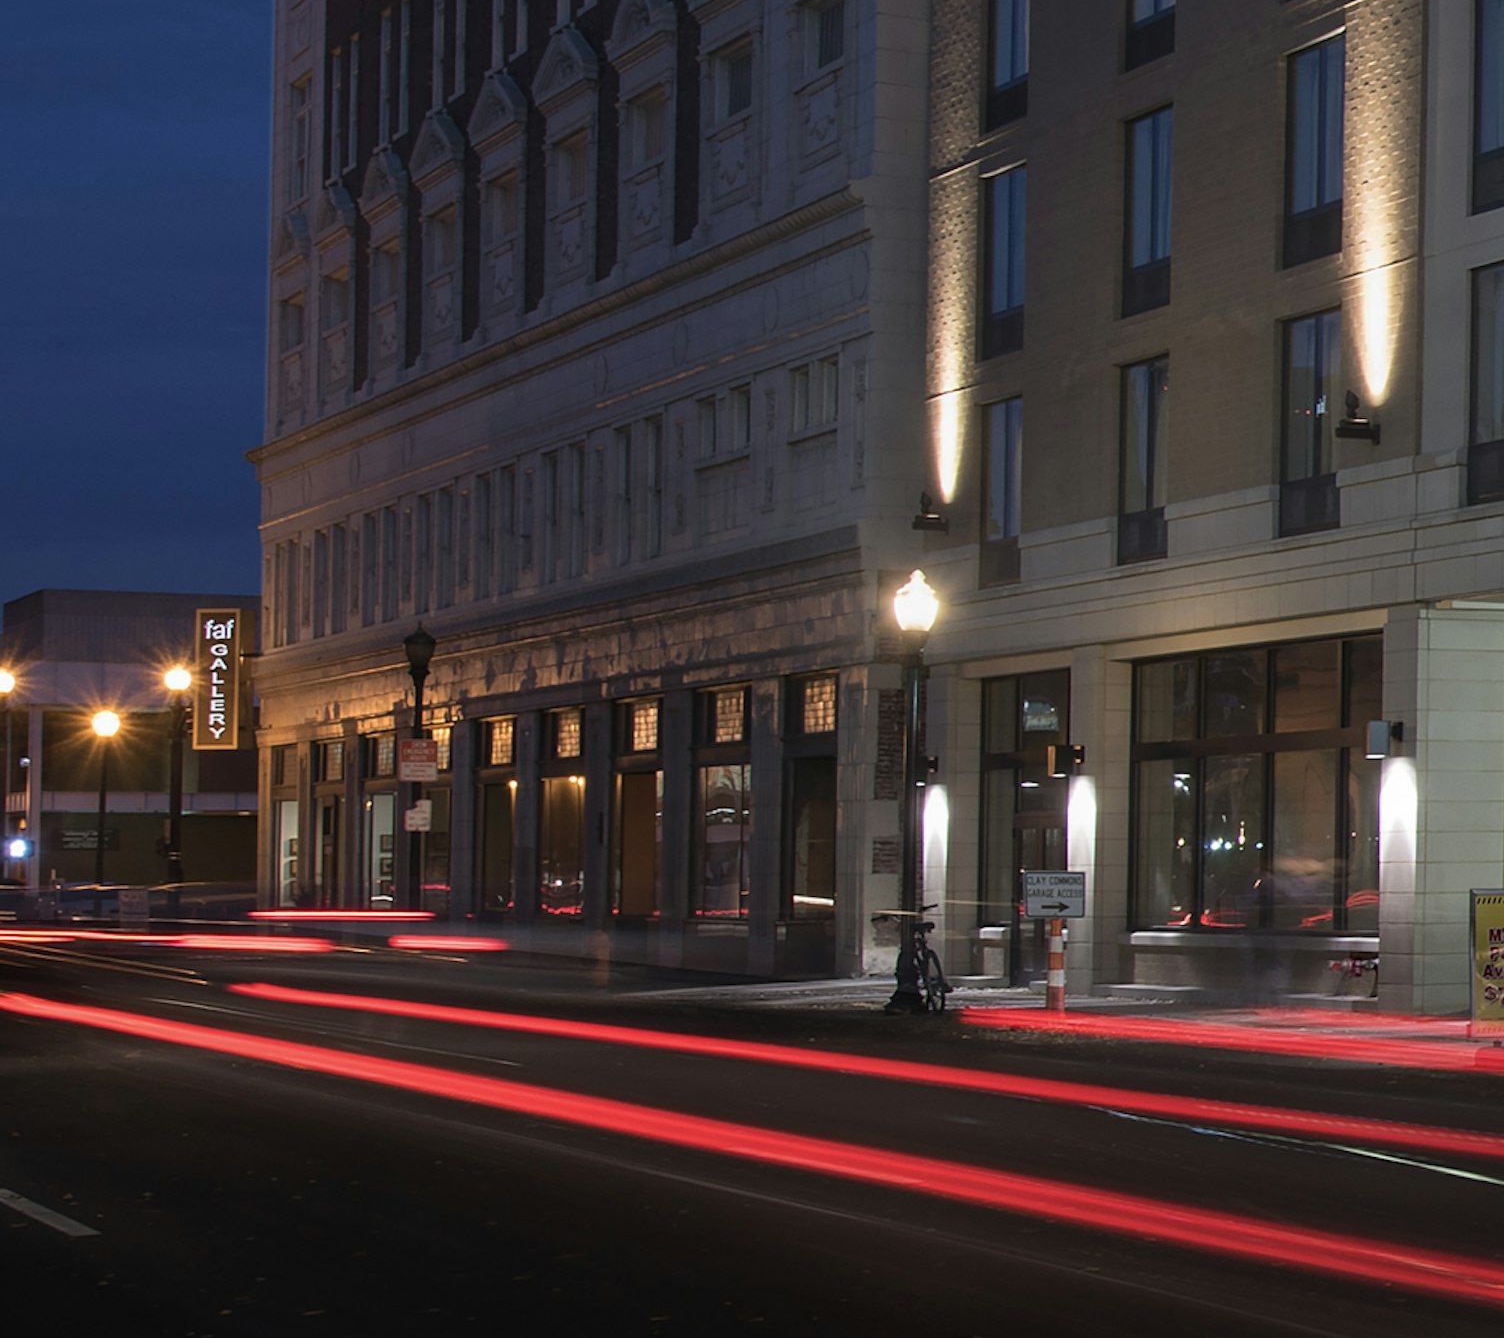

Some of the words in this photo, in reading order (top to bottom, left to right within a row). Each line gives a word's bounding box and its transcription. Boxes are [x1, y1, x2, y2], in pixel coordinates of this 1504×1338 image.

[208, 642, 229, 740] GALLERY
[1027, 876, 1047, 886] CLAY
[1049, 876, 1082, 886] COMMONS
[1028, 888, 1054, 898] GARAGE
[1057, 888, 1083, 898] ACCESS
